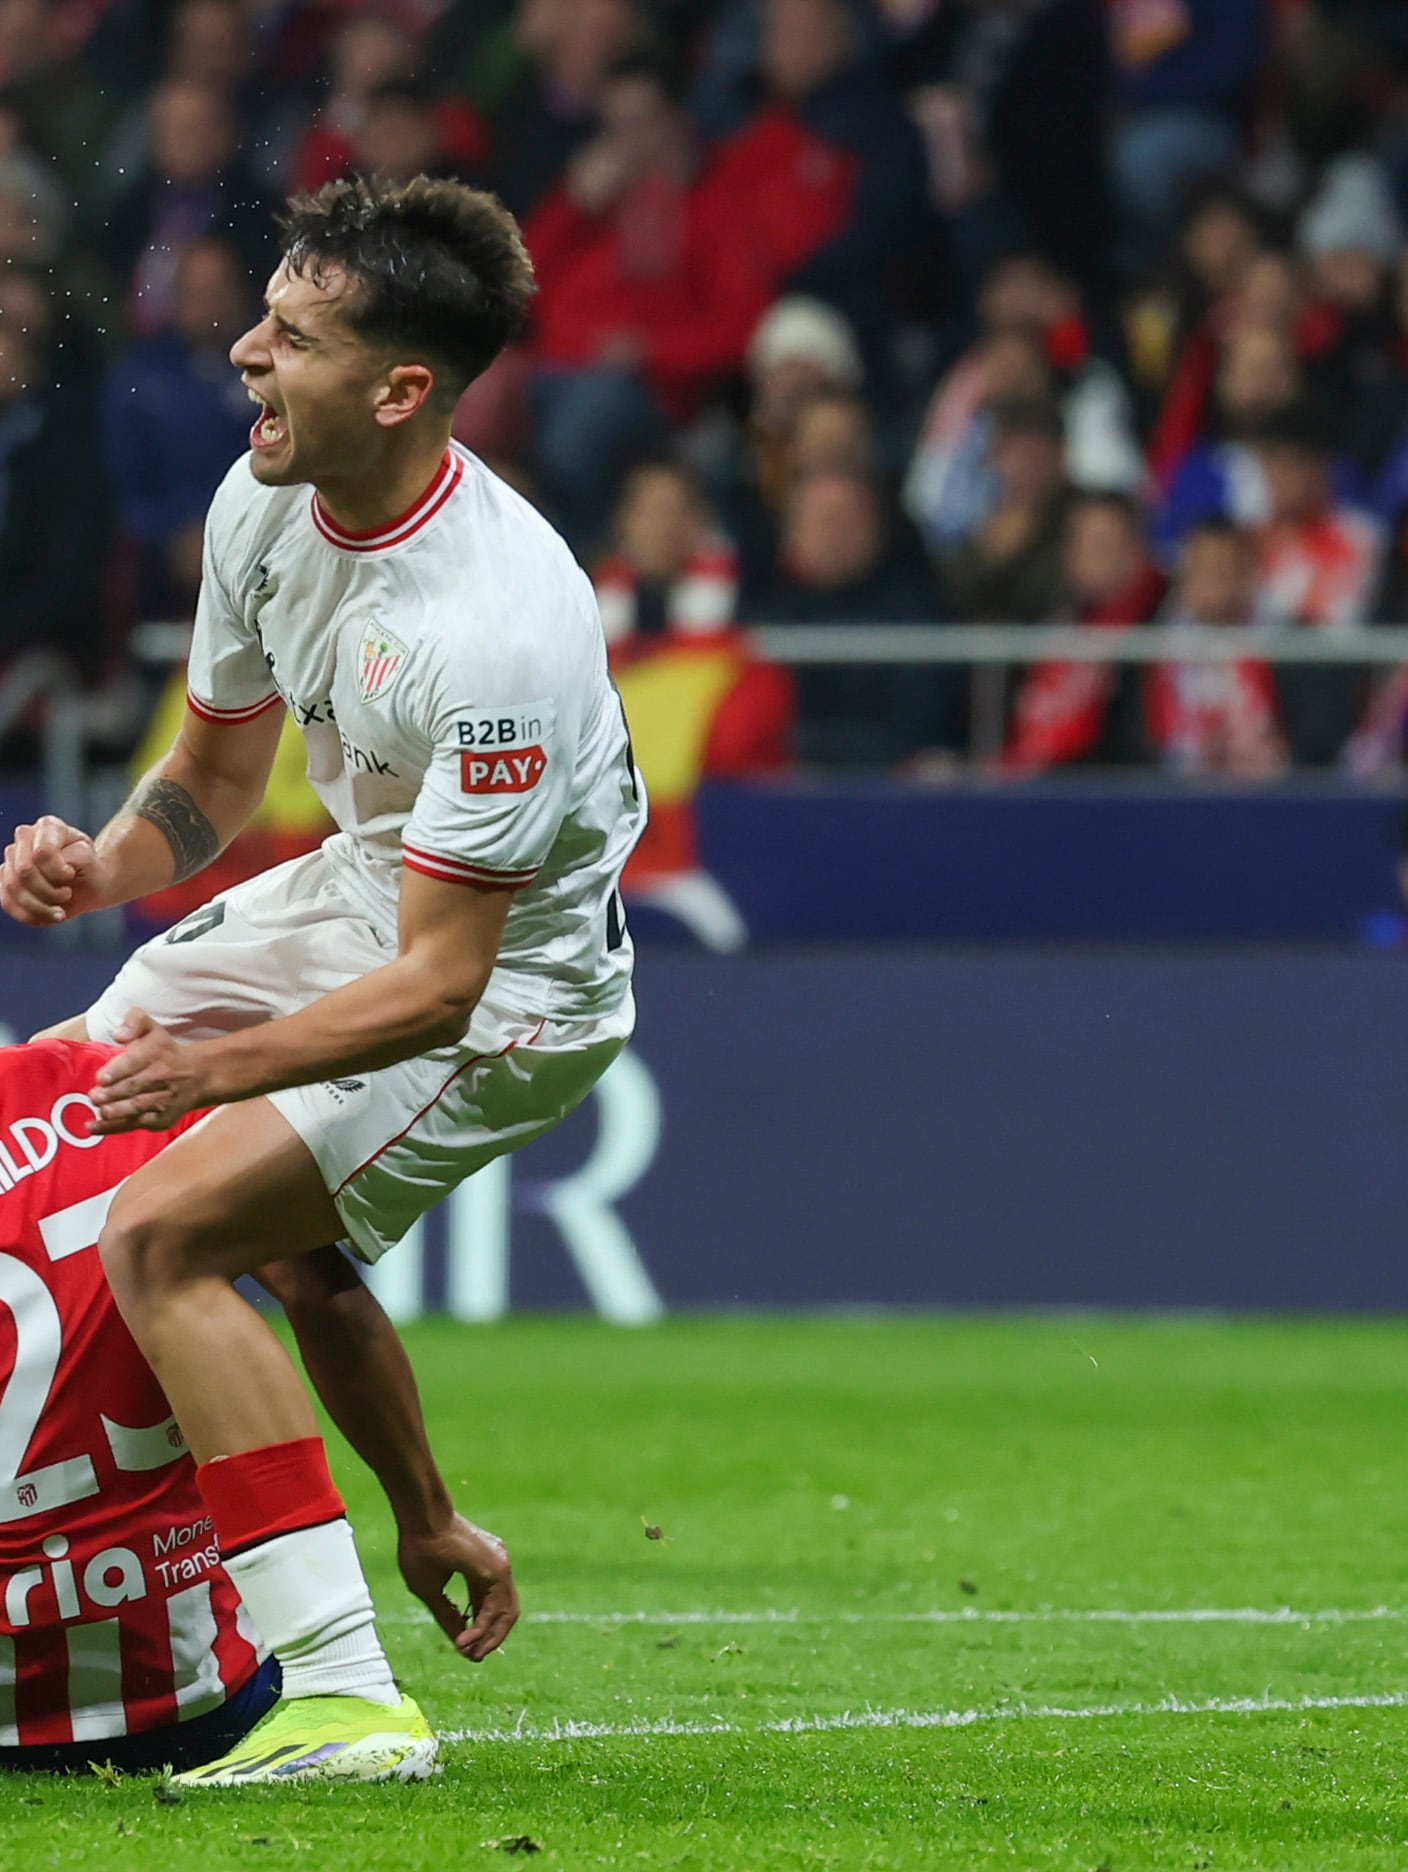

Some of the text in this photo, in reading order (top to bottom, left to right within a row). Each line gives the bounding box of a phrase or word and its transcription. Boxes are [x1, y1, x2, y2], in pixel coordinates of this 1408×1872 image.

[468, 755, 532, 786] PAY
[153, 1515, 213, 1557] Mone
[5, 1534, 147, 1627] ria
